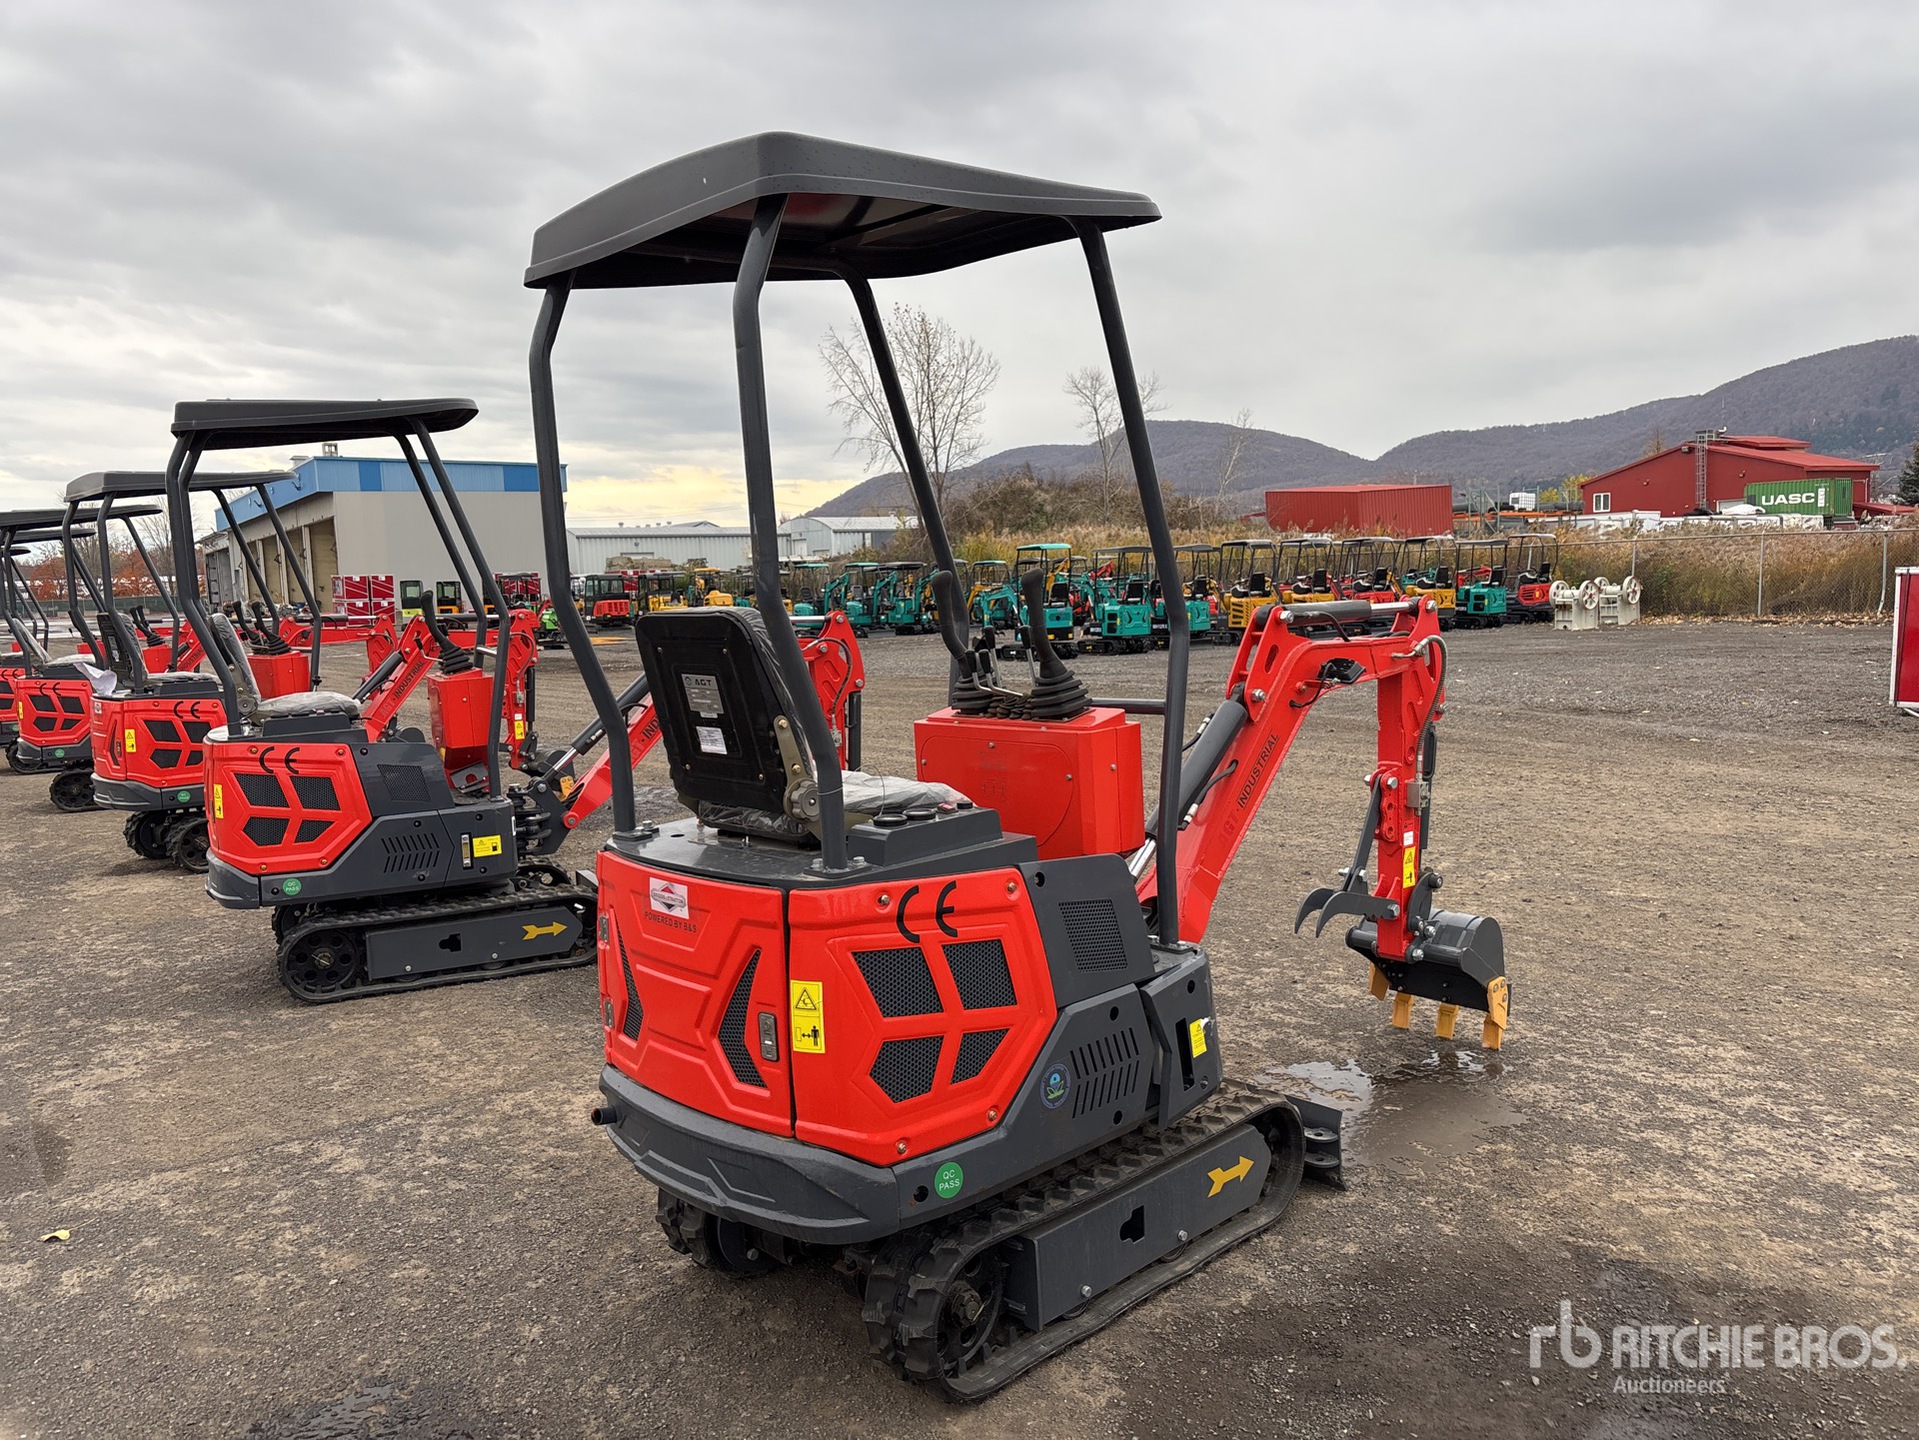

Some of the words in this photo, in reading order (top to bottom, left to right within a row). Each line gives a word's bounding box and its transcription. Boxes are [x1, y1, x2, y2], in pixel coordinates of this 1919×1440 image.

[1761, 493, 1816, 506] UASC
[393, 661, 425, 699] INDUSTRIAL
[694, 678, 712, 687] AGT
[173, 700, 201, 719] CE
[259, 746, 300, 774] CE
[1237, 733, 1279, 810] INDUSTRIAL
[645, 911, 673, 927] POWERED
[673, 919, 683, 929] BY
[896, 880, 958, 944] CE
[942, 1169, 956, 1180] QC
[938, 1178, 960, 1191] PASS
